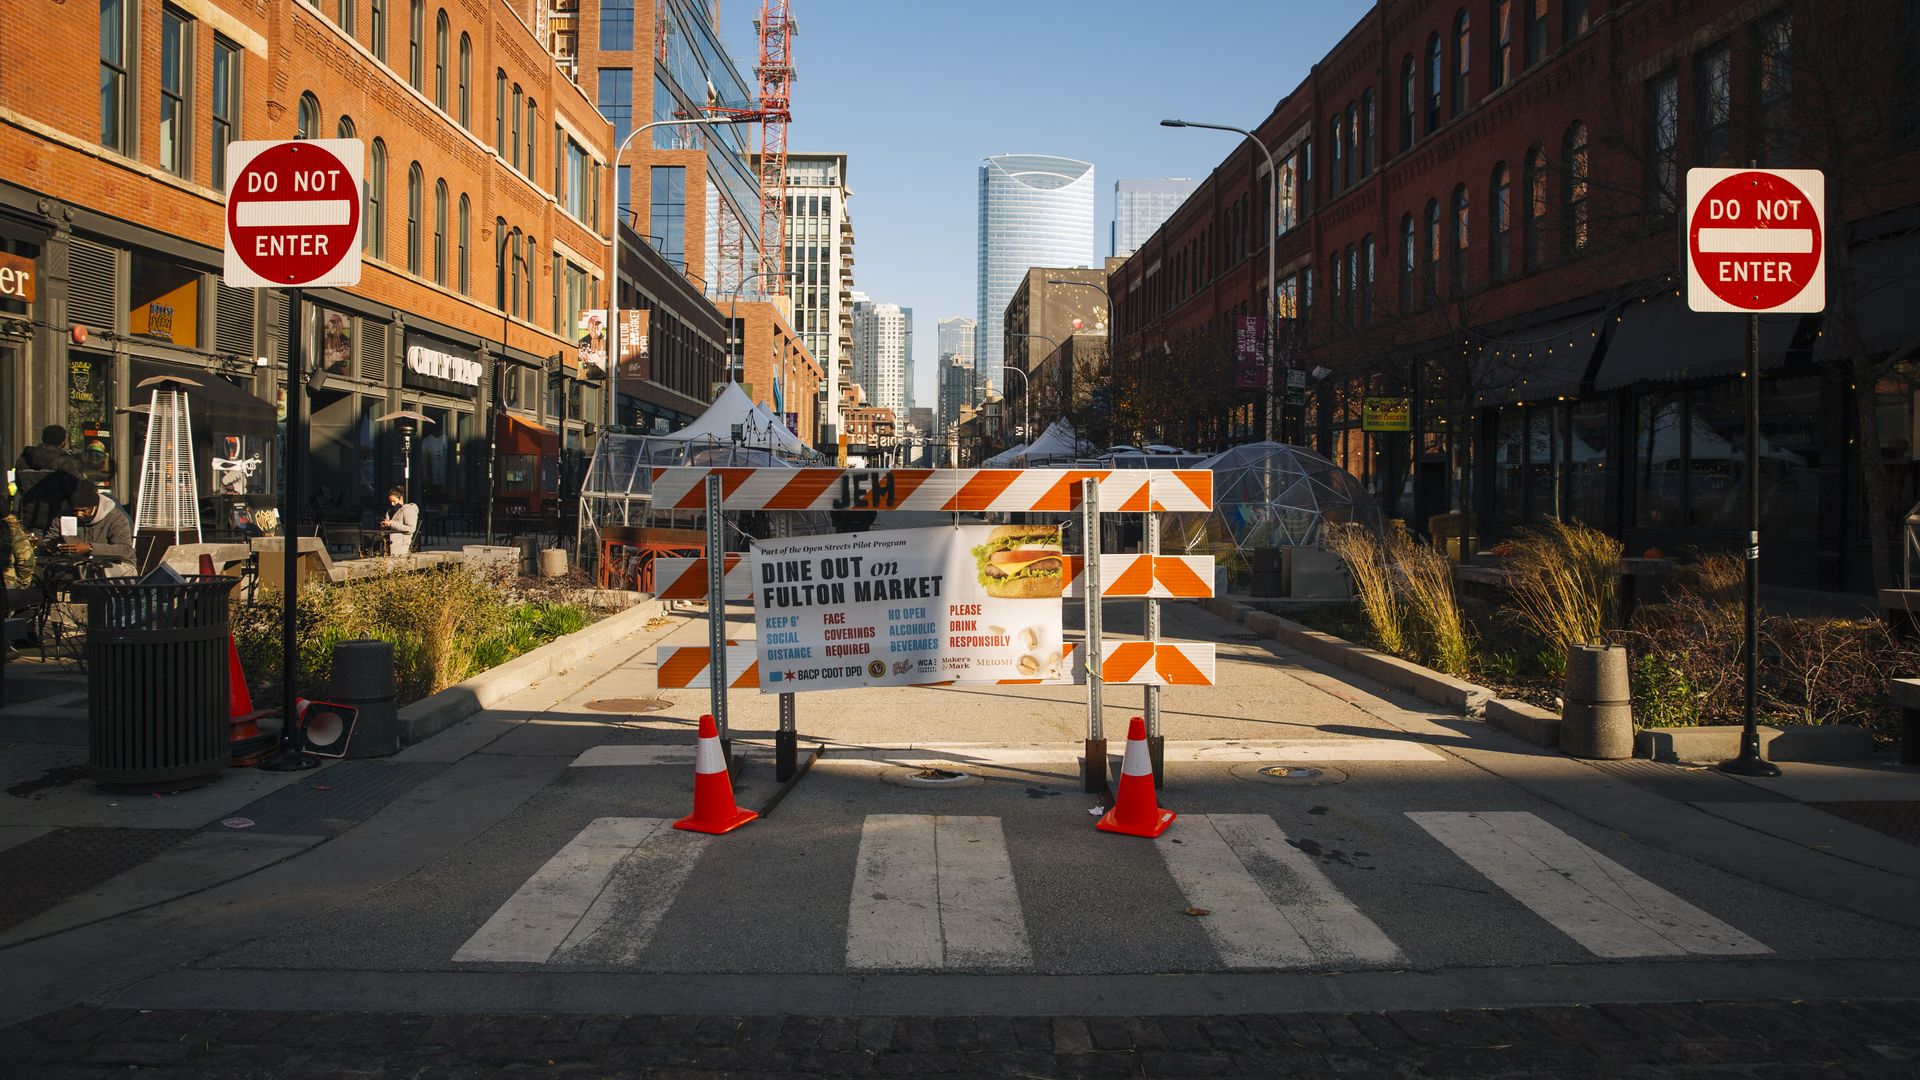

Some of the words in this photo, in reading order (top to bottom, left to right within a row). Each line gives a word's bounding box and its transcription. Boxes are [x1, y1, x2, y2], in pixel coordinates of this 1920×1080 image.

[248, 171, 278, 193] DO
[294, 170, 340, 192] NOT
[1710, 199, 1740, 220] DO
[1757, 199, 1802, 220] NOT
[256, 234, 329, 257] ENTER
[1719, 261, 1792, 282] ENTER
[629, 310, 640, 346] MARKET
[620, 322, 630, 355] FULTON
[407, 345, 452, 380] CITY
[452, 356, 483, 387] TAP
[761, 547, 779, 555] Part
[779, 546, 789, 556] of
[789, 546, 801, 554] the
[803, 544, 823, 554] Open
[824, 543, 851, 551] Streets
[853, 541, 872, 549] Pilot
[873, 539, 906, 549] Program
[761, 560, 813, 584] DINE
[820, 556, 863, 580] OUT
[870, 560, 899, 577] on
[763, 582, 845, 609] FULTON
[854, 575, 943, 603] MARKET
[888, 609, 901, 621] NO
[903, 607, 926, 620] OPEN
[950, 604, 982, 616] PLEASE
[766, 616, 788, 629] KEEP
[823, 612, 846, 625] FACE
[950, 620, 977, 632] DRINK
[824, 626, 876, 641] COVERINGS
[889, 622, 936, 637] ALCOHOLIC
[767, 632, 799, 645] SOCIAL
[890, 638, 938, 653] BEVERAGES
[950, 635, 1011, 648] RESPONSIBLY
[768, 647, 812, 661] DISTANCE
[825, 643, 870, 658] REQUIRED
[941, 656, 971, 664] Maker's
[948, 662, 970, 670] Mark
[797, 669, 820, 681] BACP
[822, 667, 843, 679] CDOT
[845, 665, 863, 677] DPD
